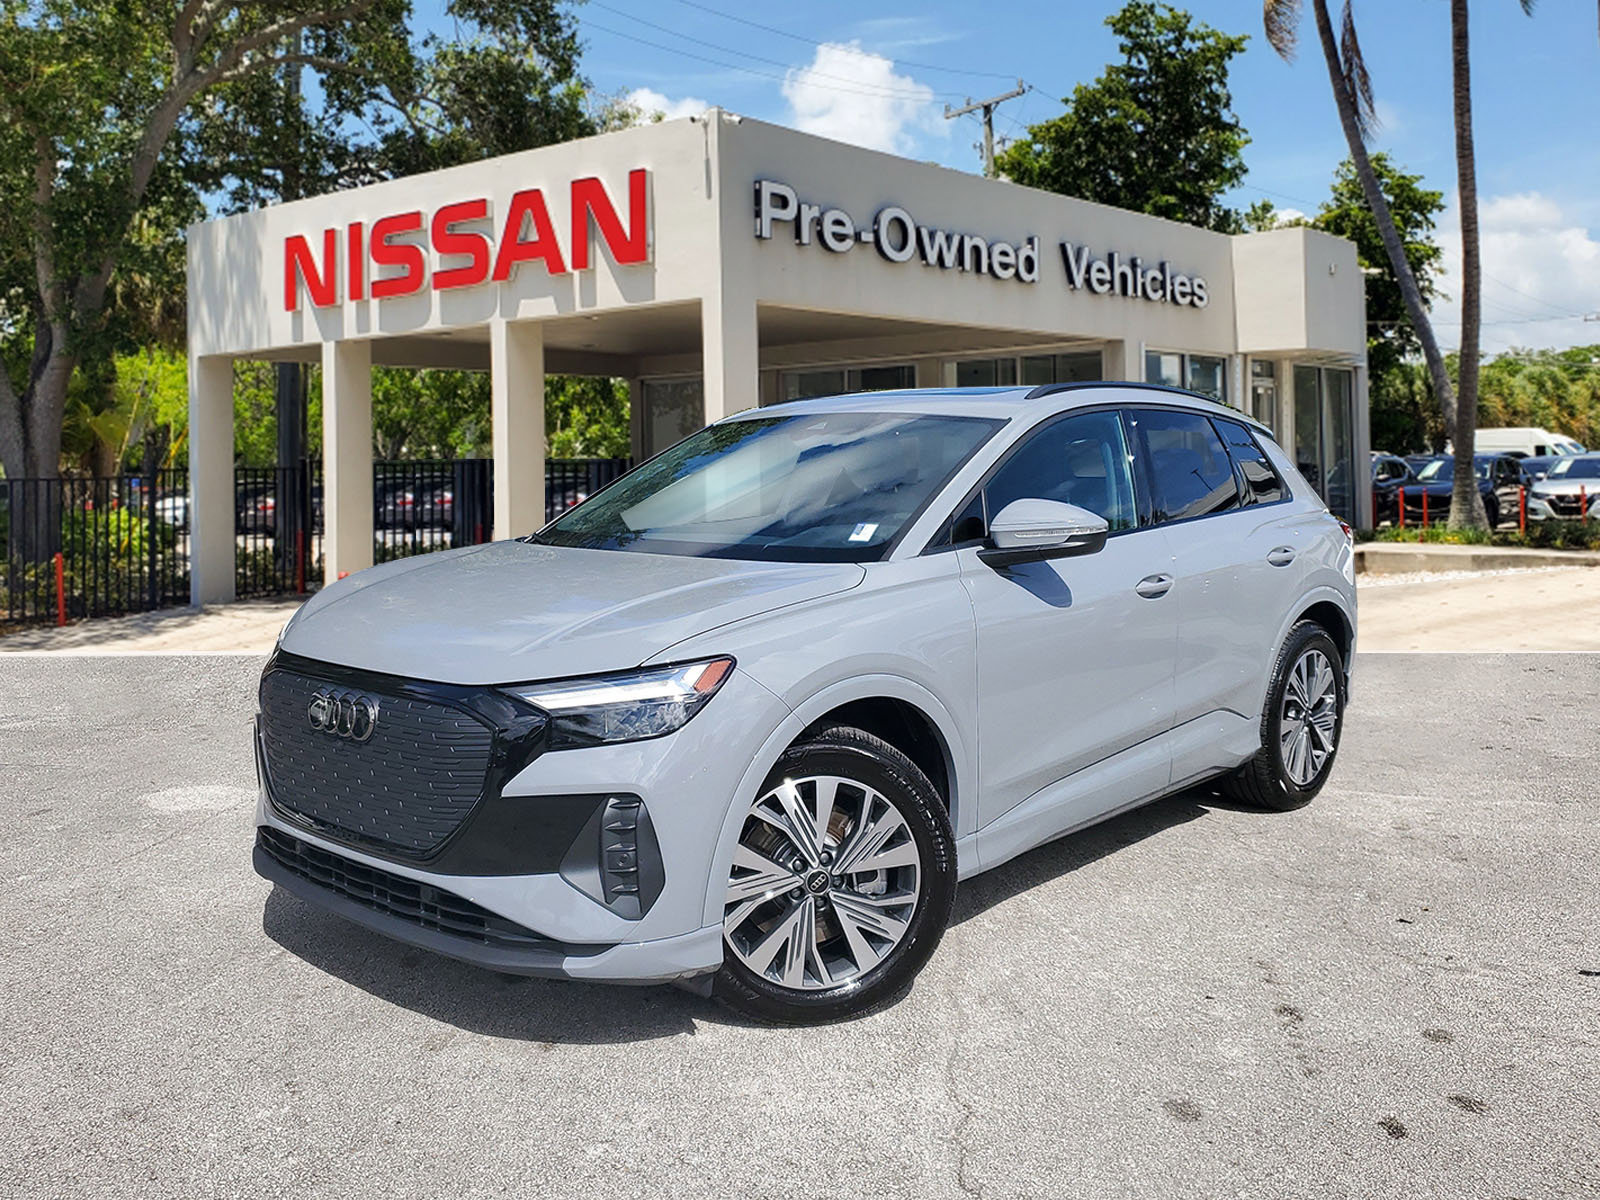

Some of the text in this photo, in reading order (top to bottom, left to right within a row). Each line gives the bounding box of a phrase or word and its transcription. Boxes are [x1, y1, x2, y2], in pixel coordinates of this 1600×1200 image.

[285, 169, 648, 312] NISSAN
[754, 179, 1209, 309] Pre-Owned Vehicles
